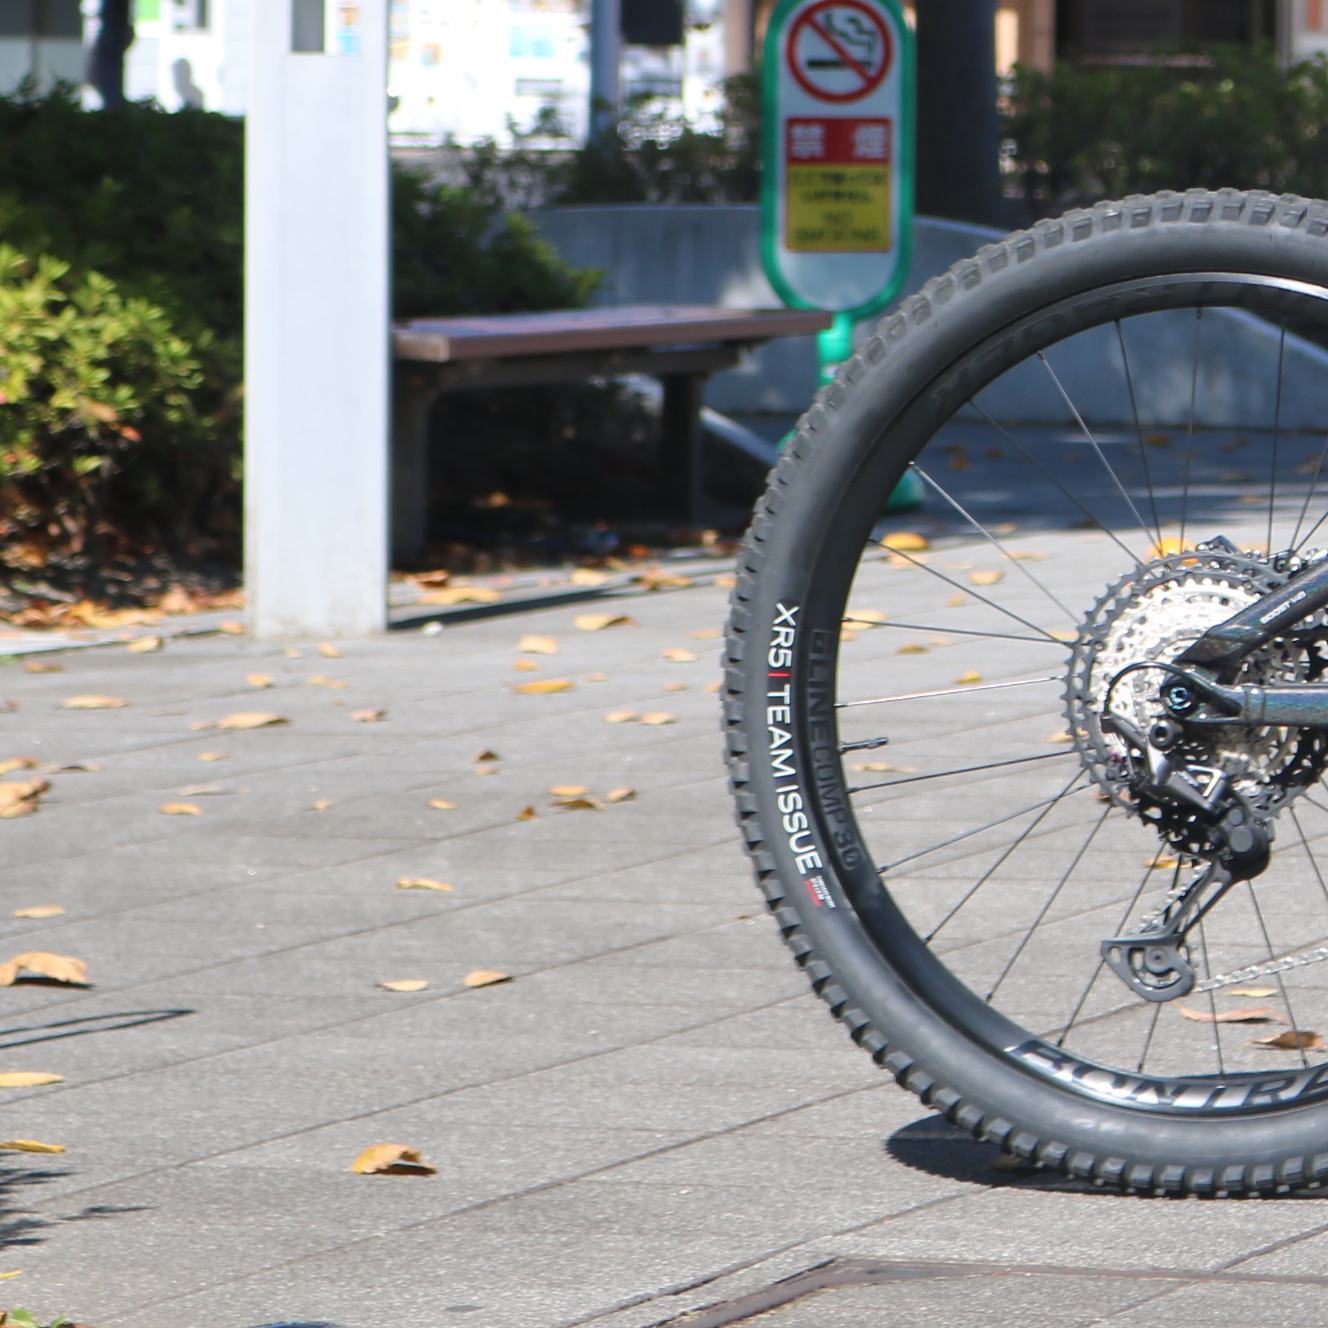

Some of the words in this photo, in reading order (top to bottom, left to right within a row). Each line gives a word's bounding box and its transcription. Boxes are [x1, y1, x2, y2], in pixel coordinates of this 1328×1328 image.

[768, 602, 799, 669] XR5
[766, 683, 797, 778] TEAM
[775, 784, 823, 876] ISSUE
